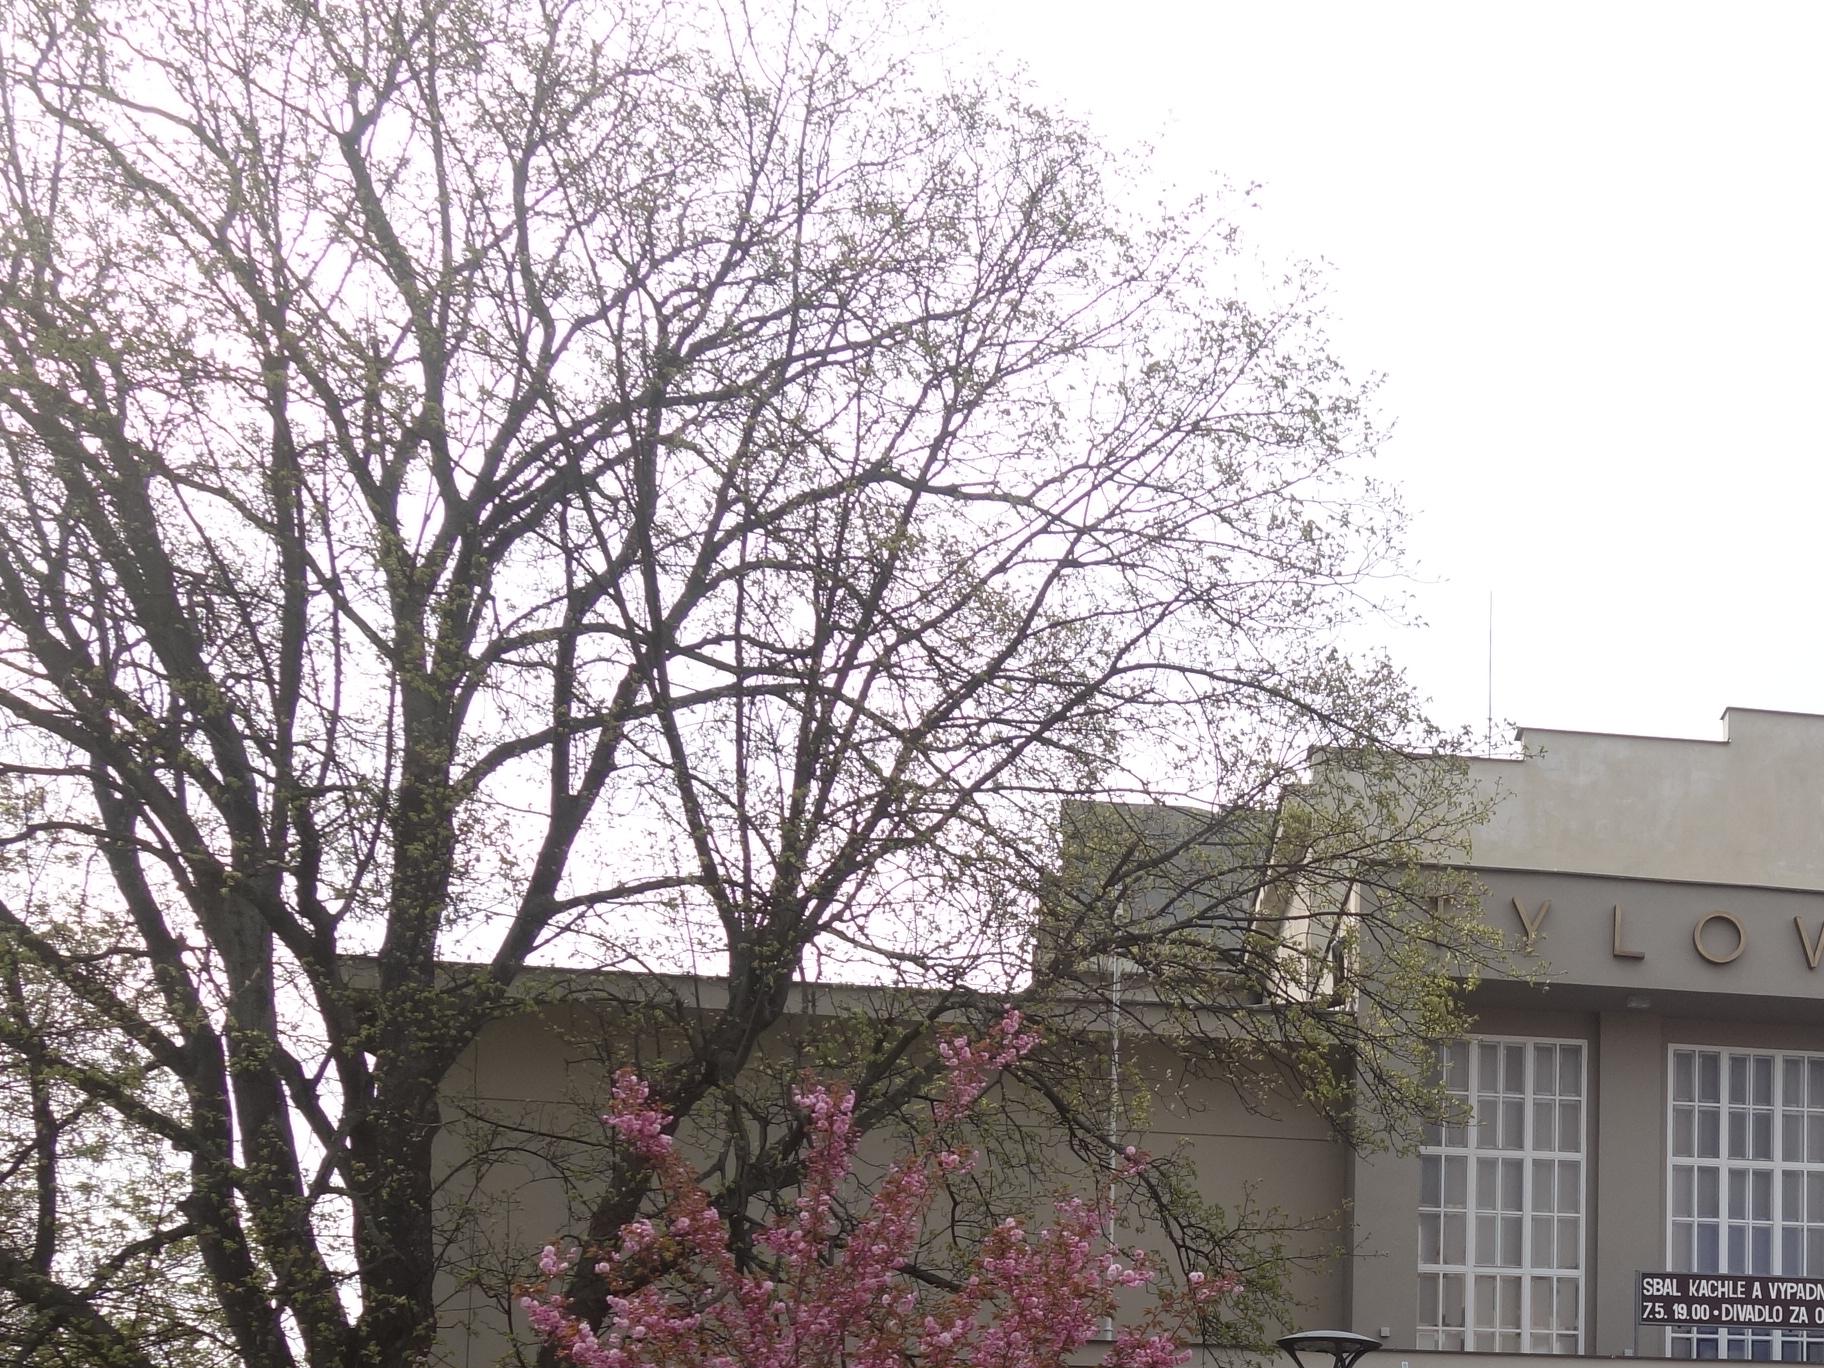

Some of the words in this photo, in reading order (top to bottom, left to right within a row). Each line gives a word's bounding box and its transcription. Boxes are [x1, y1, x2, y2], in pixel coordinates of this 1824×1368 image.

[1643, 1278, 1681, 1296] SBAL
[1689, 1279, 1746, 1298] KACHLE
[1752, 1282, 1762, 1299] A
[1672, 1303, 1710, 1320] 19.00
[1722, 1304, 1783, 1323] DIVADLO
[1789, 1306, 1808, 1324] ZA
